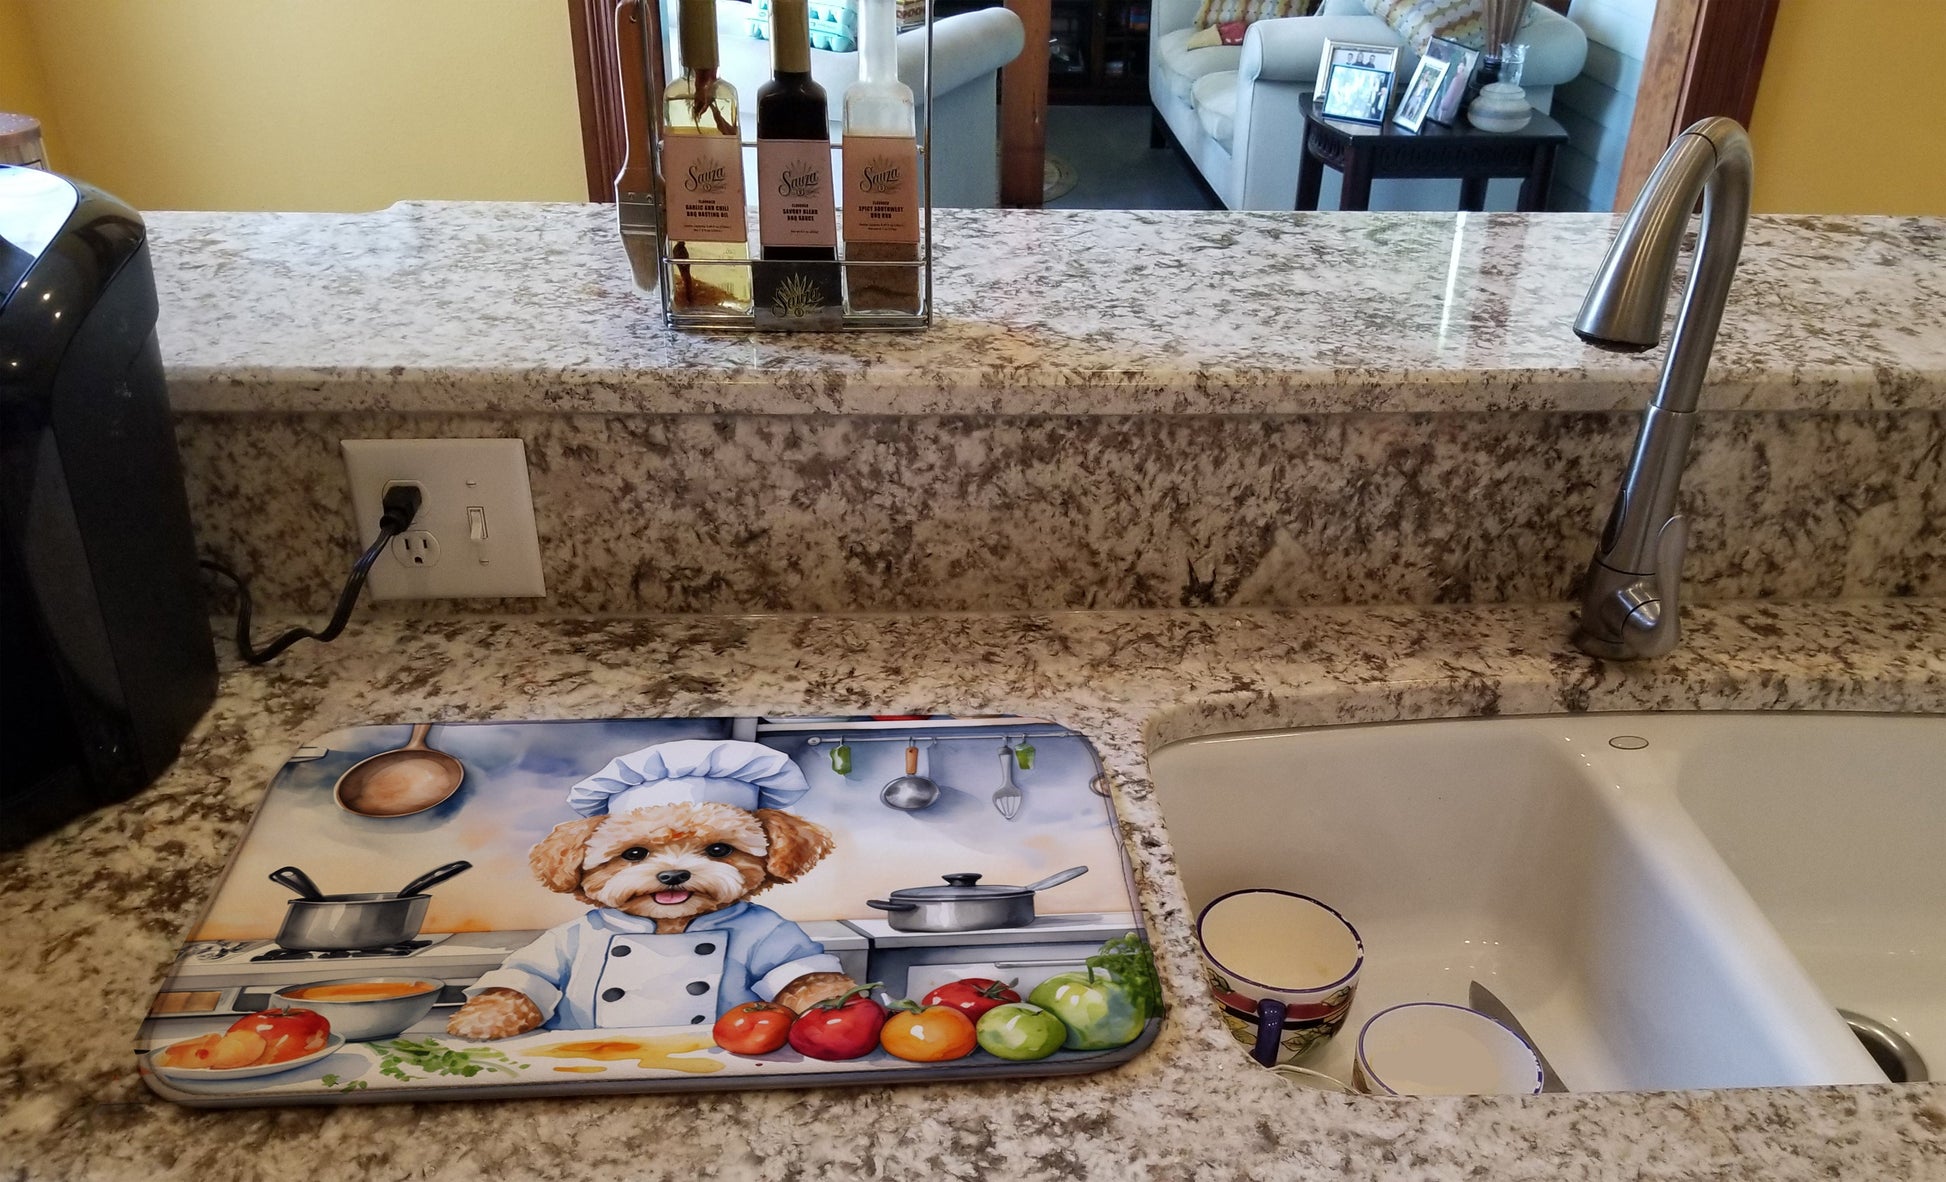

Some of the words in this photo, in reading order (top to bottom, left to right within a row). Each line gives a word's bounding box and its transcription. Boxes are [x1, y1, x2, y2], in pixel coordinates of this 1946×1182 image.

[685, 166, 726, 192] Sauza
[778, 170, 818, 197] Sauza
[860, 166, 900, 192] Sauza
[771, 288, 822, 318] Sauza
